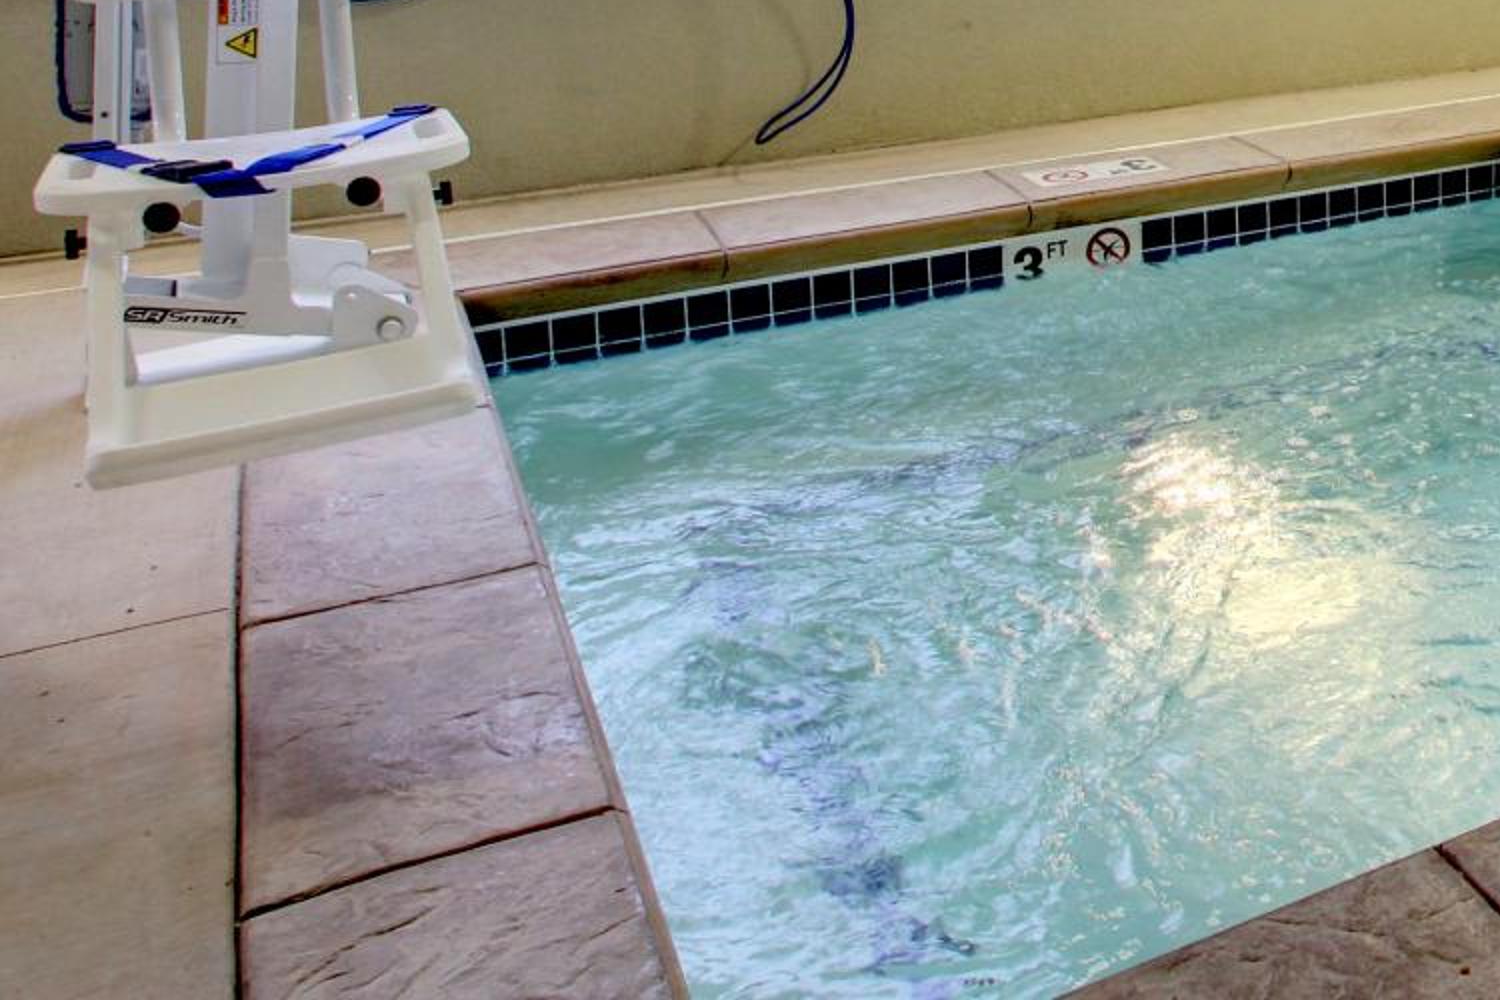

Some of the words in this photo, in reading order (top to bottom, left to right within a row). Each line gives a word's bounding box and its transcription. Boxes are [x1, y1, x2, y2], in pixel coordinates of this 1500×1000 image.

[1013, 246, 1044, 280] 3
[1047, 239, 1068, 259] FT
[127, 309, 164, 322] SR
[166, 311, 238, 325] Smith
